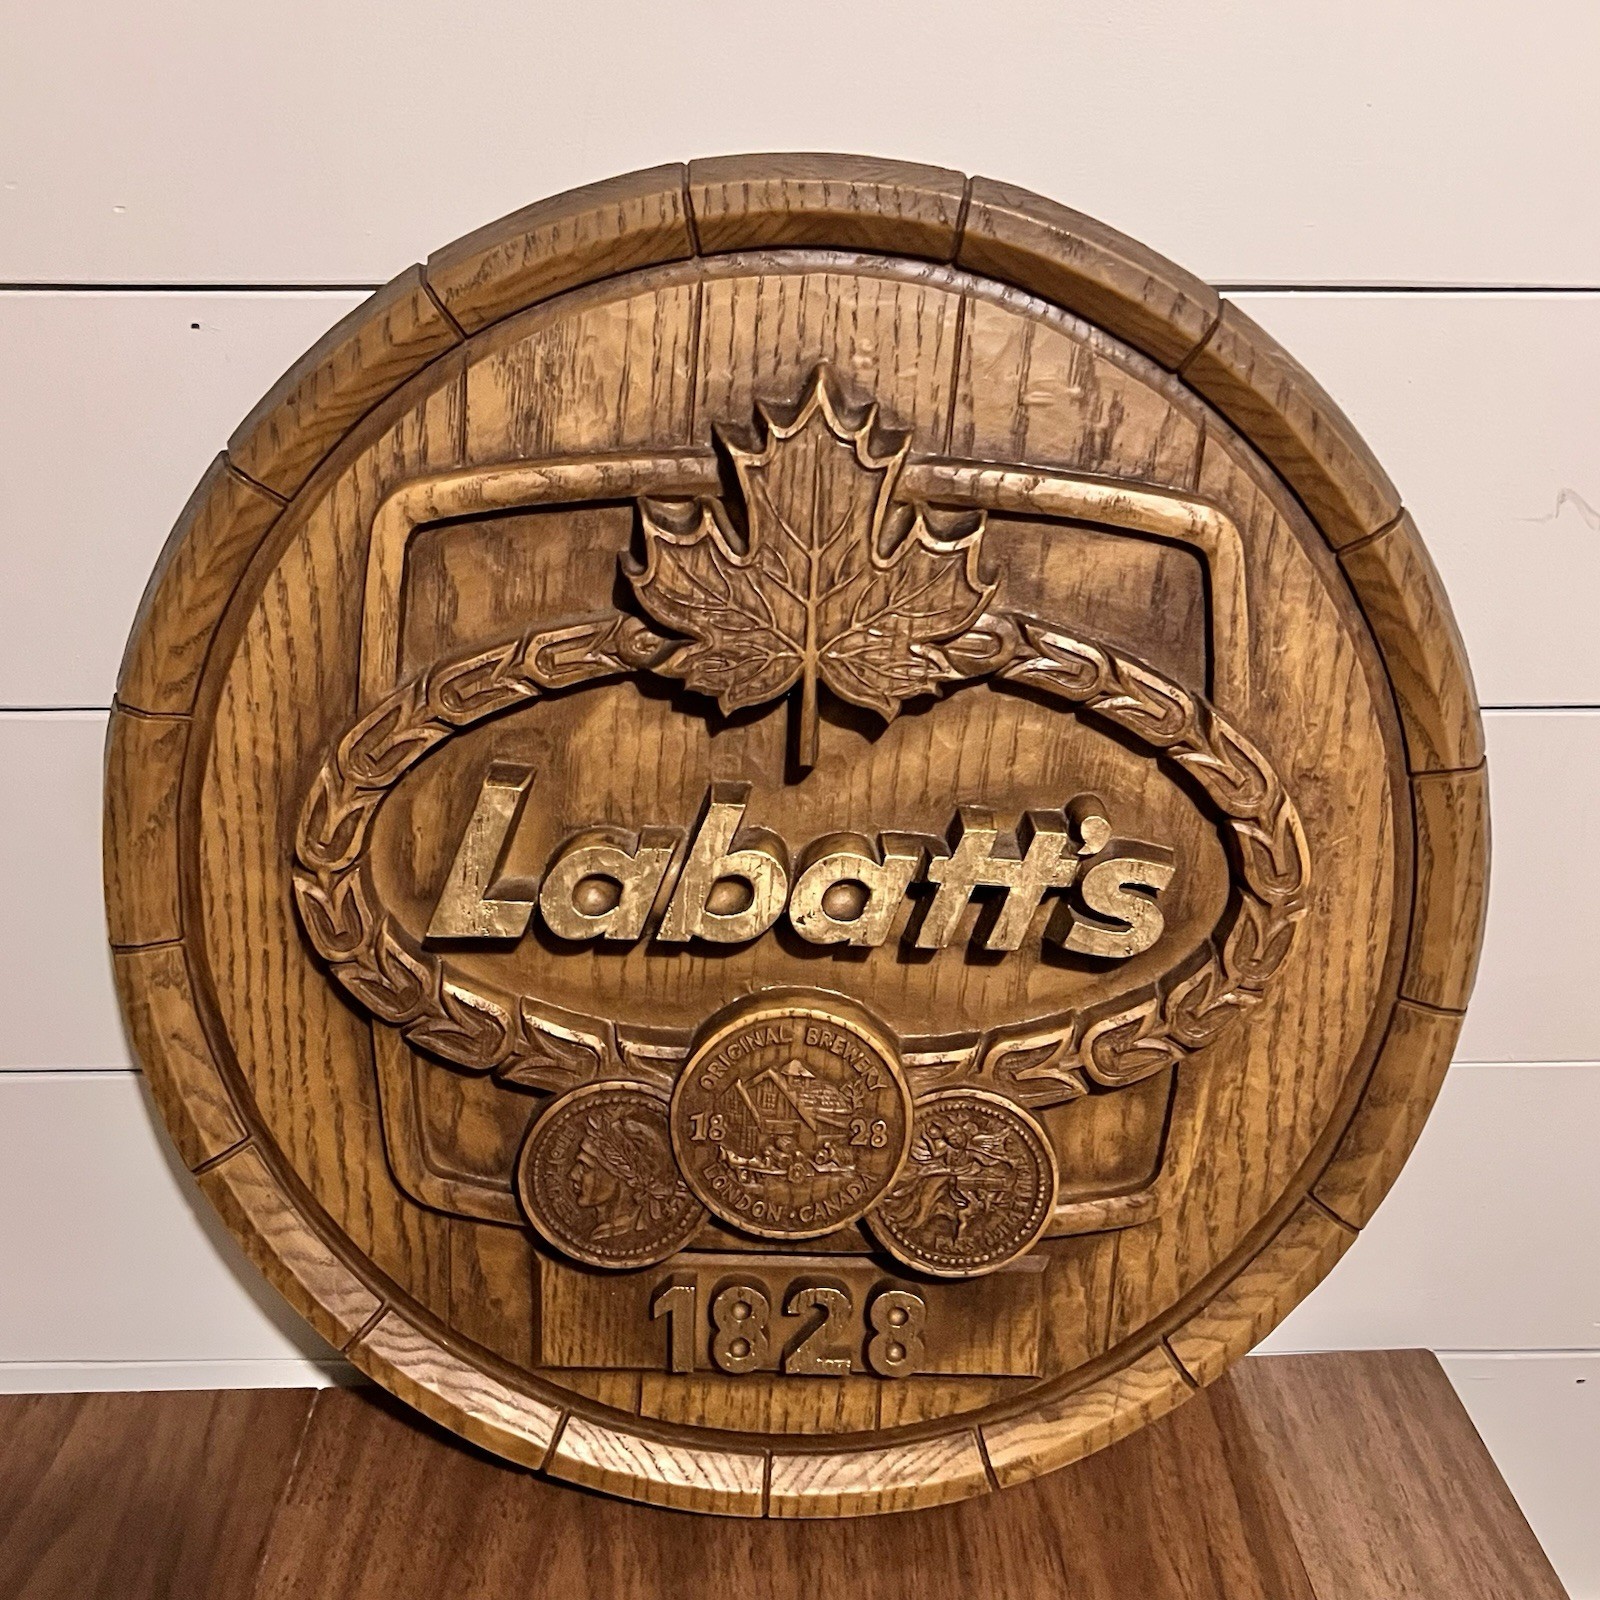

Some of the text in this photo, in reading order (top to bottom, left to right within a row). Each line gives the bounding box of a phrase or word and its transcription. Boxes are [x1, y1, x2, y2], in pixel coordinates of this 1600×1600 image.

[424, 772, 1177, 960] Labatt's
[700, 1024, 887, 1092] ORIGINAL BREWERY
[689, 1112, 889, 1149] 18 28
[702, 1162, 877, 1224] LONDON CANADA
[652, 1279, 929, 1378] 1828
